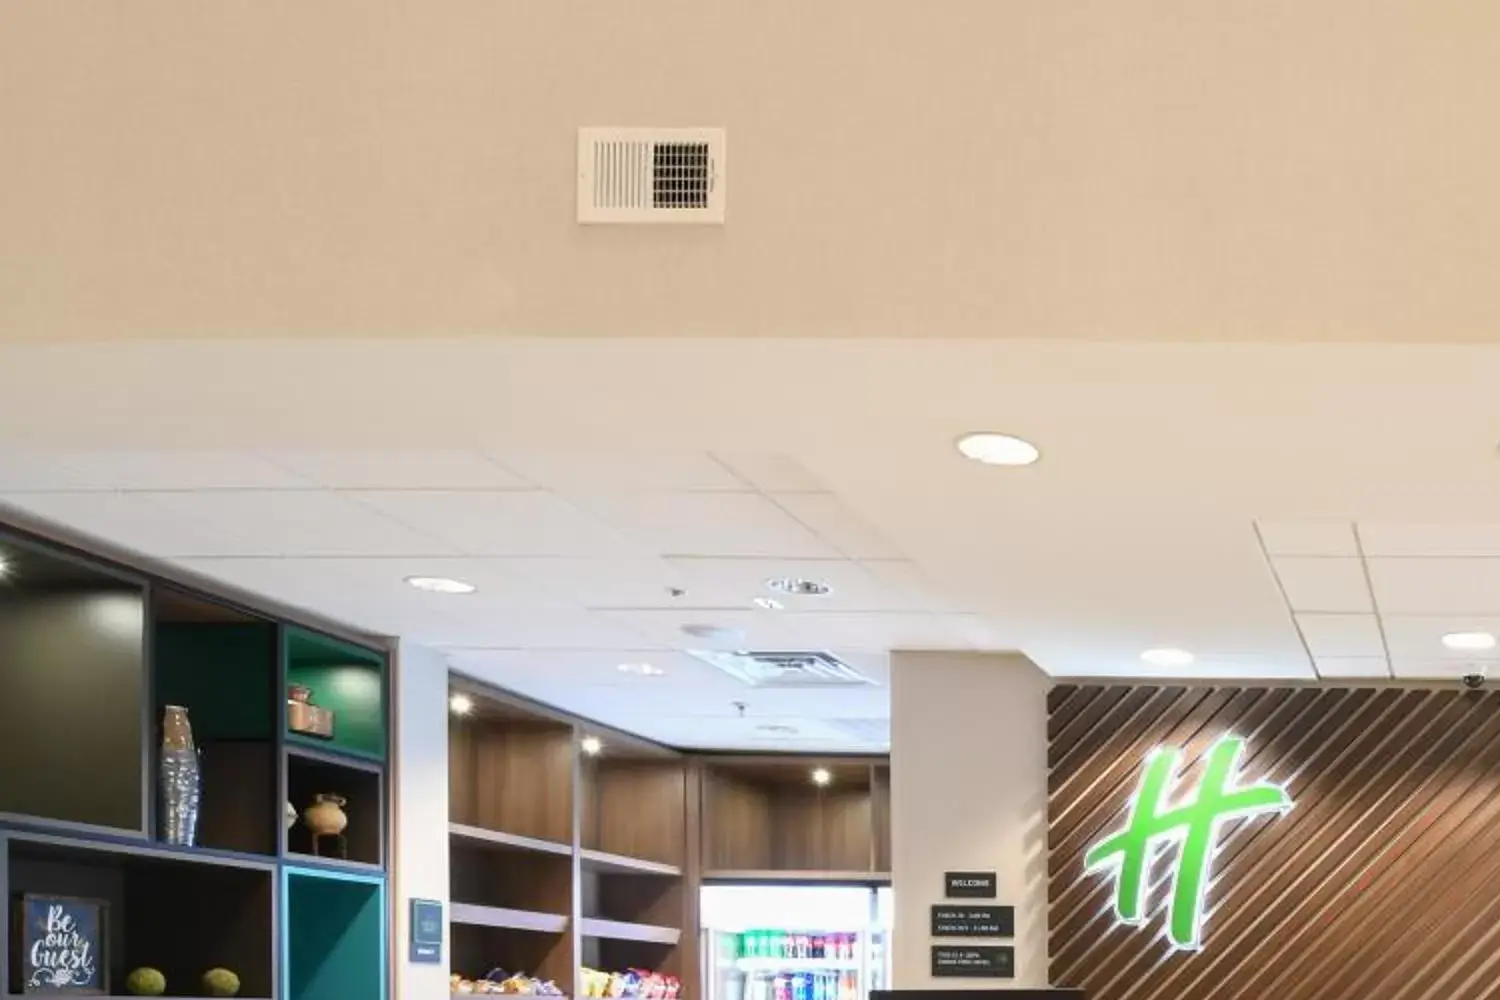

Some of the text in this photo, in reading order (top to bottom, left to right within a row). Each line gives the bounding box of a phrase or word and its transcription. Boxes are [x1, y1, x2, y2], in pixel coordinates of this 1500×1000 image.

[951, 879, 989, 888] WELCOME
[48, 904, 77, 934] Be
[46, 931, 80, 950] our
[32, 940, 94, 968] Guest
